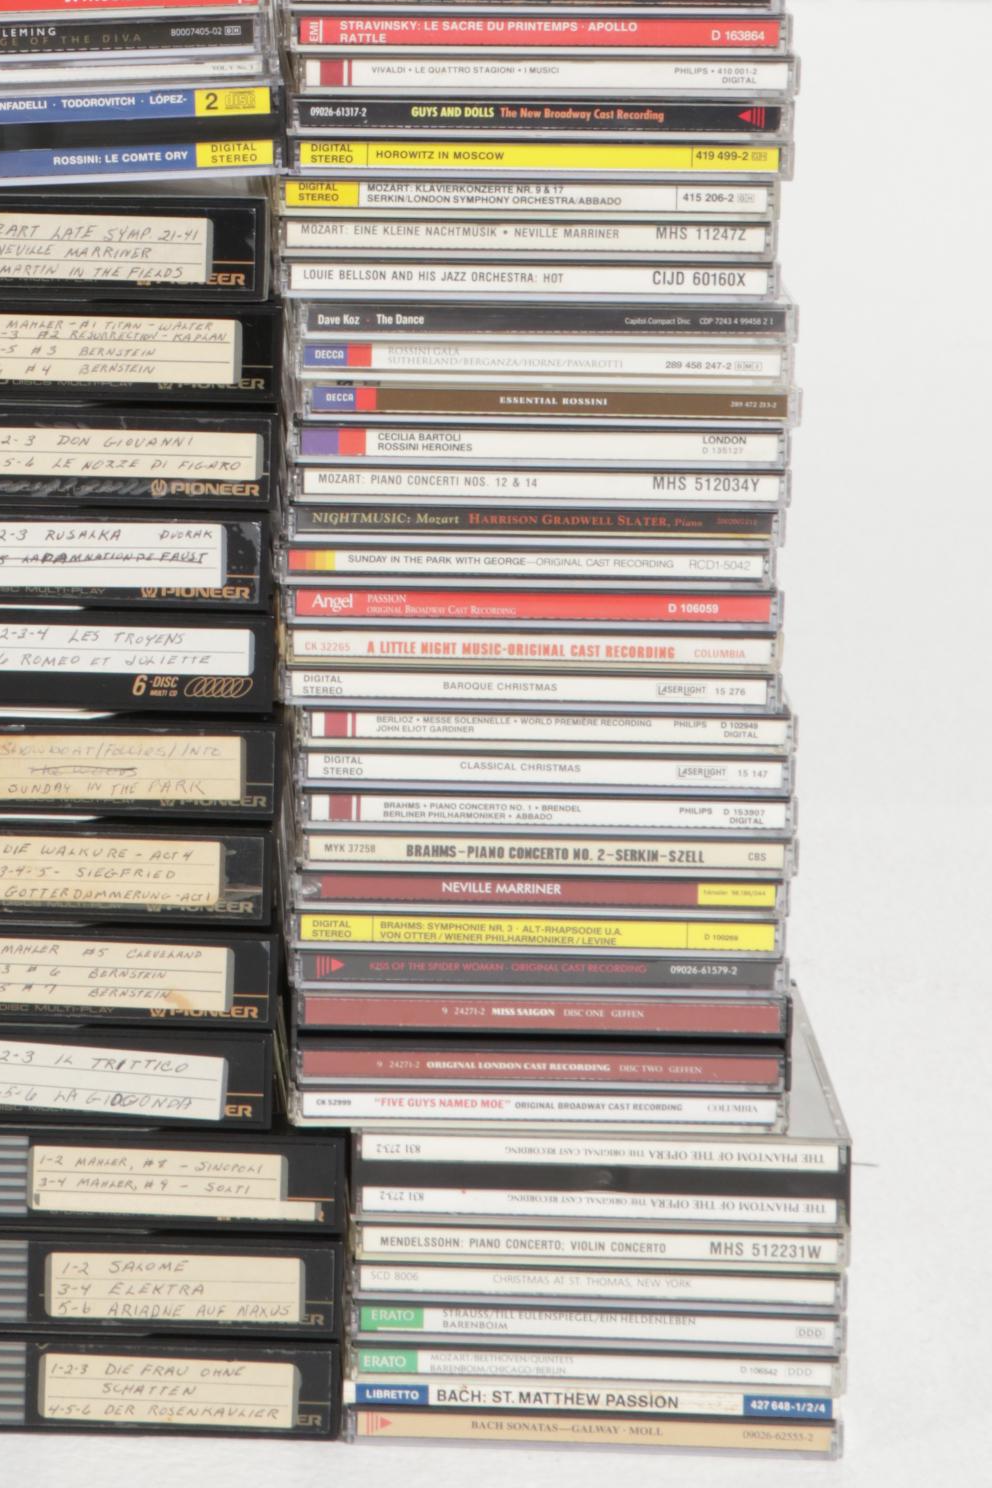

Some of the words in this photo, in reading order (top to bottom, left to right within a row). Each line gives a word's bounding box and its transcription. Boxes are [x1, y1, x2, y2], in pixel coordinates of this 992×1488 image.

[411, 106, 436, 119] GUYS
[439, 107, 462, 119] AND
[464, 108, 494, 119] DOLLS
[375, 150, 435, 161] HOROWITZ
[438, 151, 450, 161] IN
[454, 152, 505, 162] MOSCOW
[318, 314, 341, 326] Dave
[342, 314, 360, 325] Koz
[378, 433, 414, 442] CECILIA
[417, 433, 461, 442] BARTOLI
[312, 594, 354, 612] Angel
[443, 681, 495, 691] BAROQUE
[497, 682, 558, 692] CHRISTMAS
[442, 882, 492, 894] NEVILLE
[496, 883, 562, 895] MARRINER
[709, 1242, 744, 1257] MHS
[752, 1243, 822, 1260] 512231W
[366, 1390, 419, 1400] LIBRETTO
[436, 1385, 488, 1404] BACH:
[492, 1391, 514, 1405] ST.
[518, 1391, 601, 1407] MATTHEW
[605, 1394, 679, 1410] PASSION
